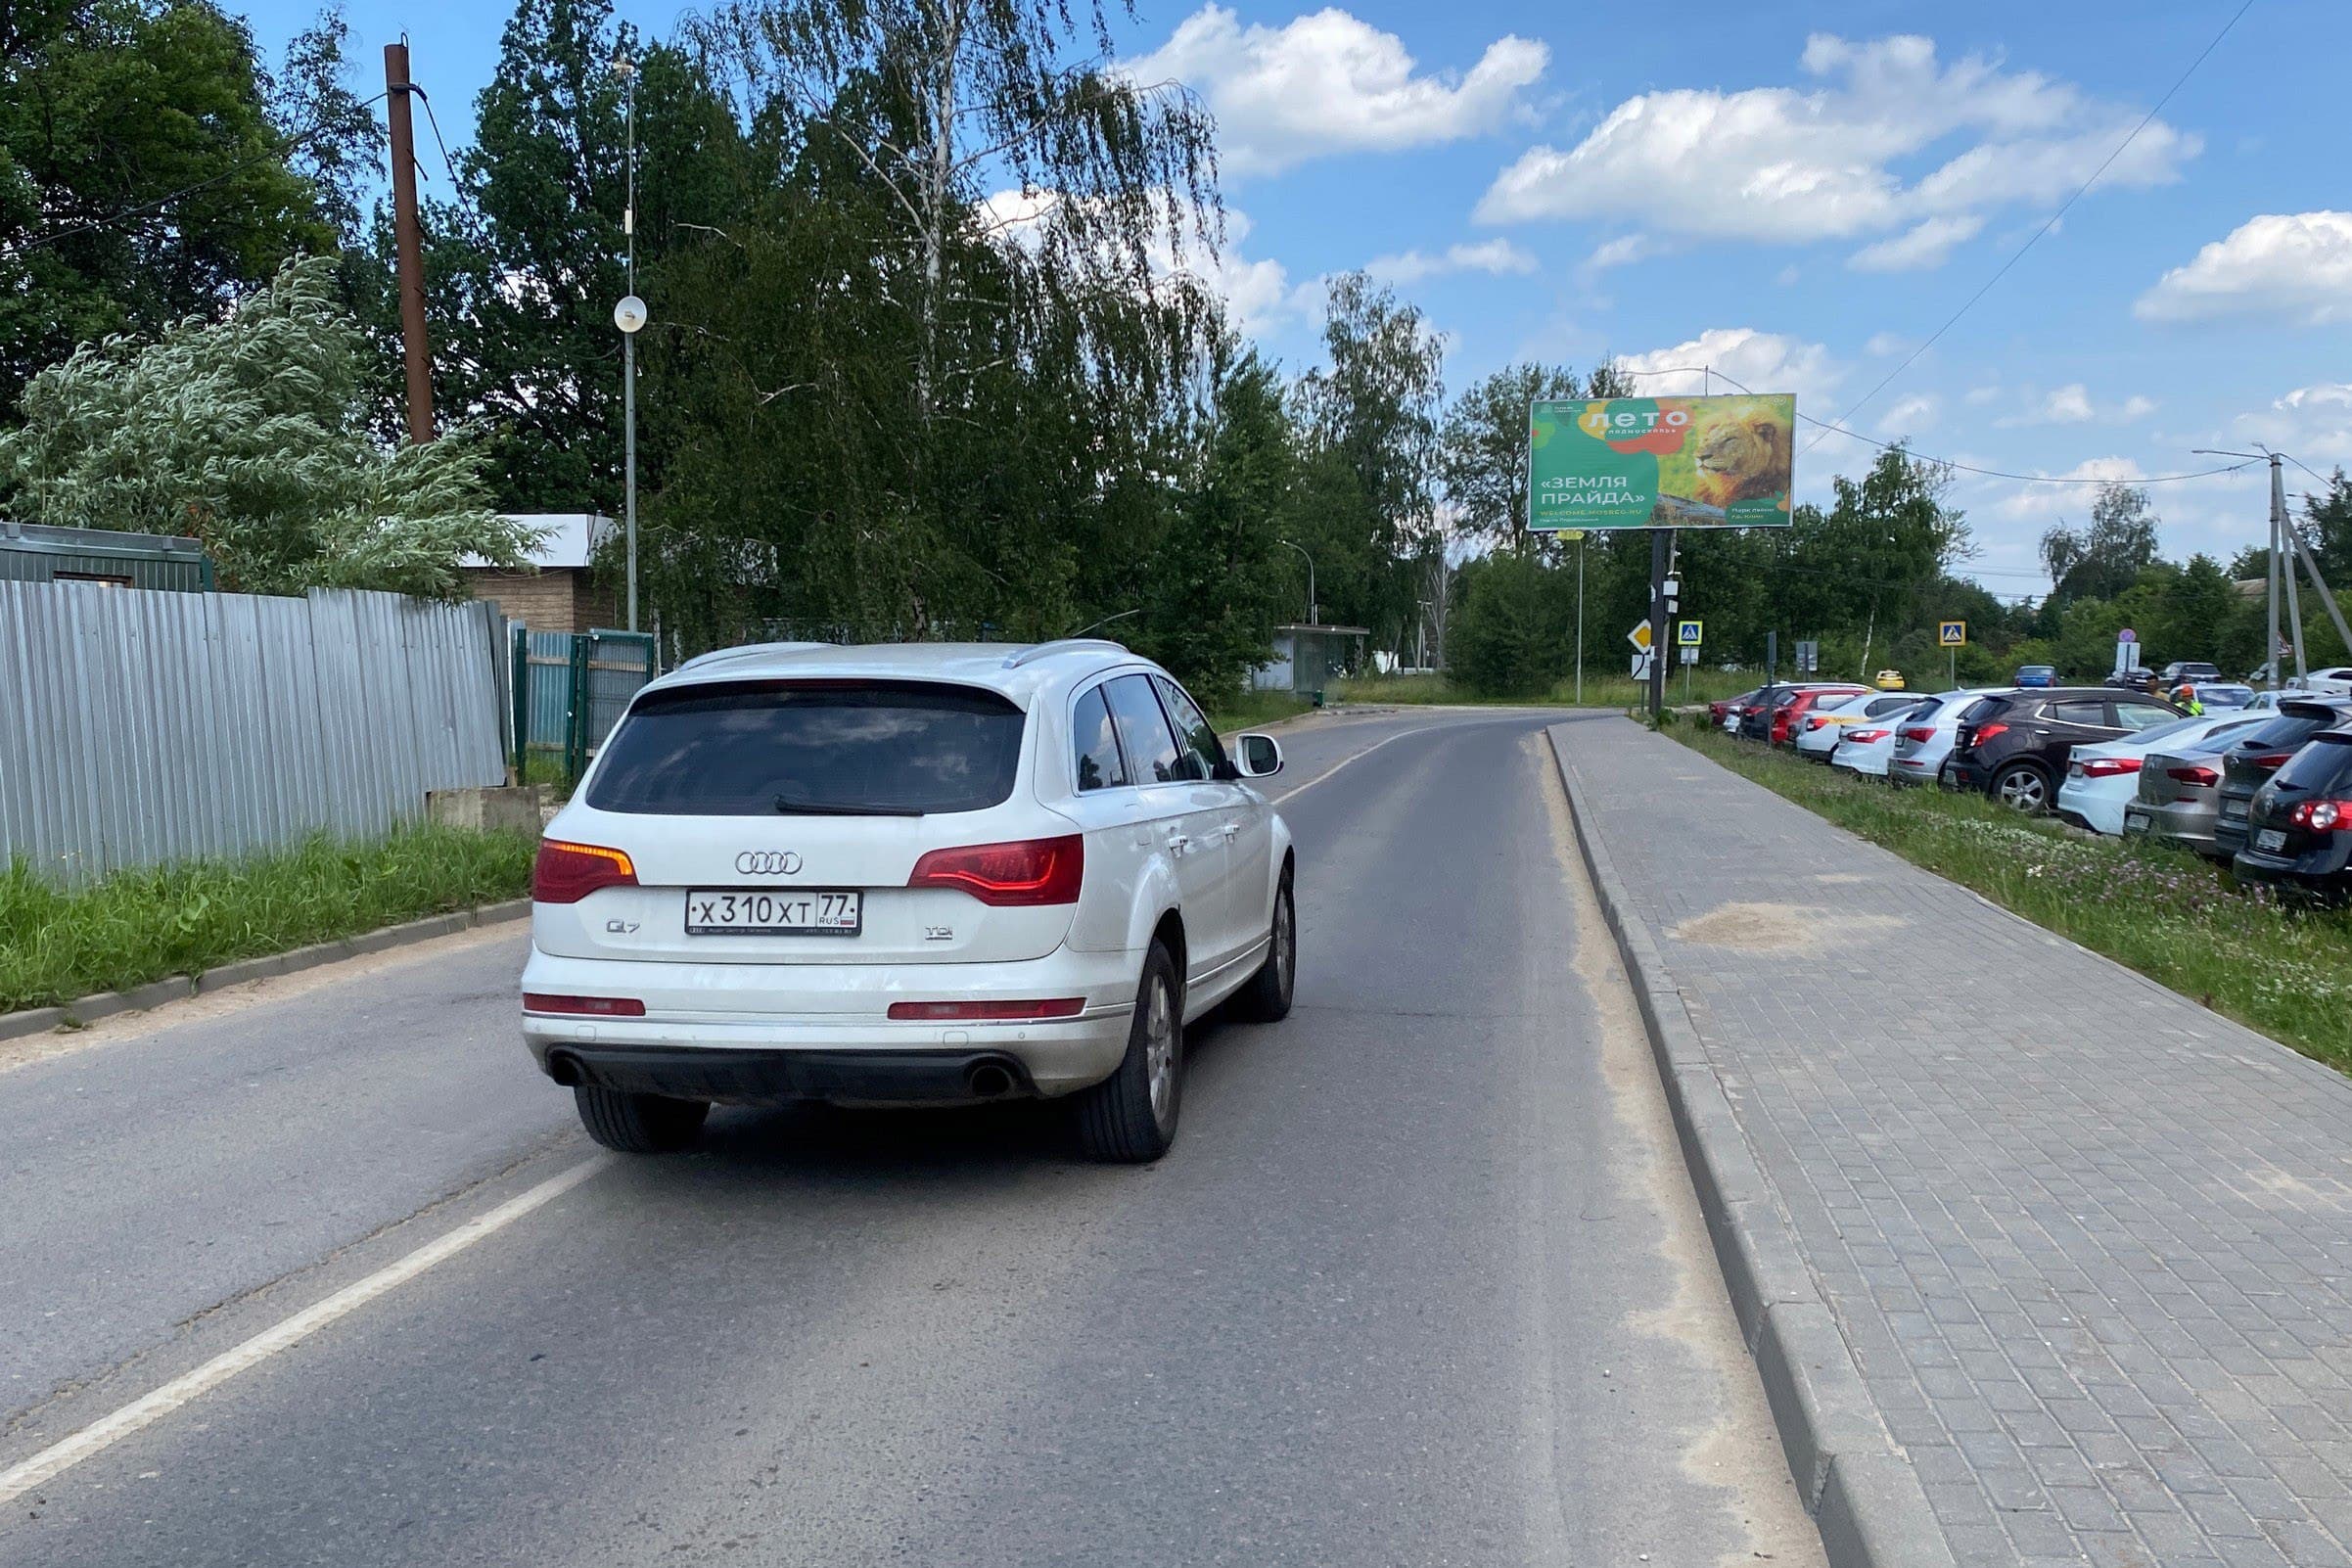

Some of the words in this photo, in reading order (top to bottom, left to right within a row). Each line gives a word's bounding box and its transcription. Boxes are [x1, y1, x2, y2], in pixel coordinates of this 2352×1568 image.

[1588, 410, 1687, 428] лето
[1541, 476, 1627, 489] «ЗЕМЛЯ
[1542, 489, 1645, 506] ПРАЙДА»
[820, 895, 850, 916] 77
[606, 920, 641, 933] Q7
[818, 916, 840, 925] RUS
